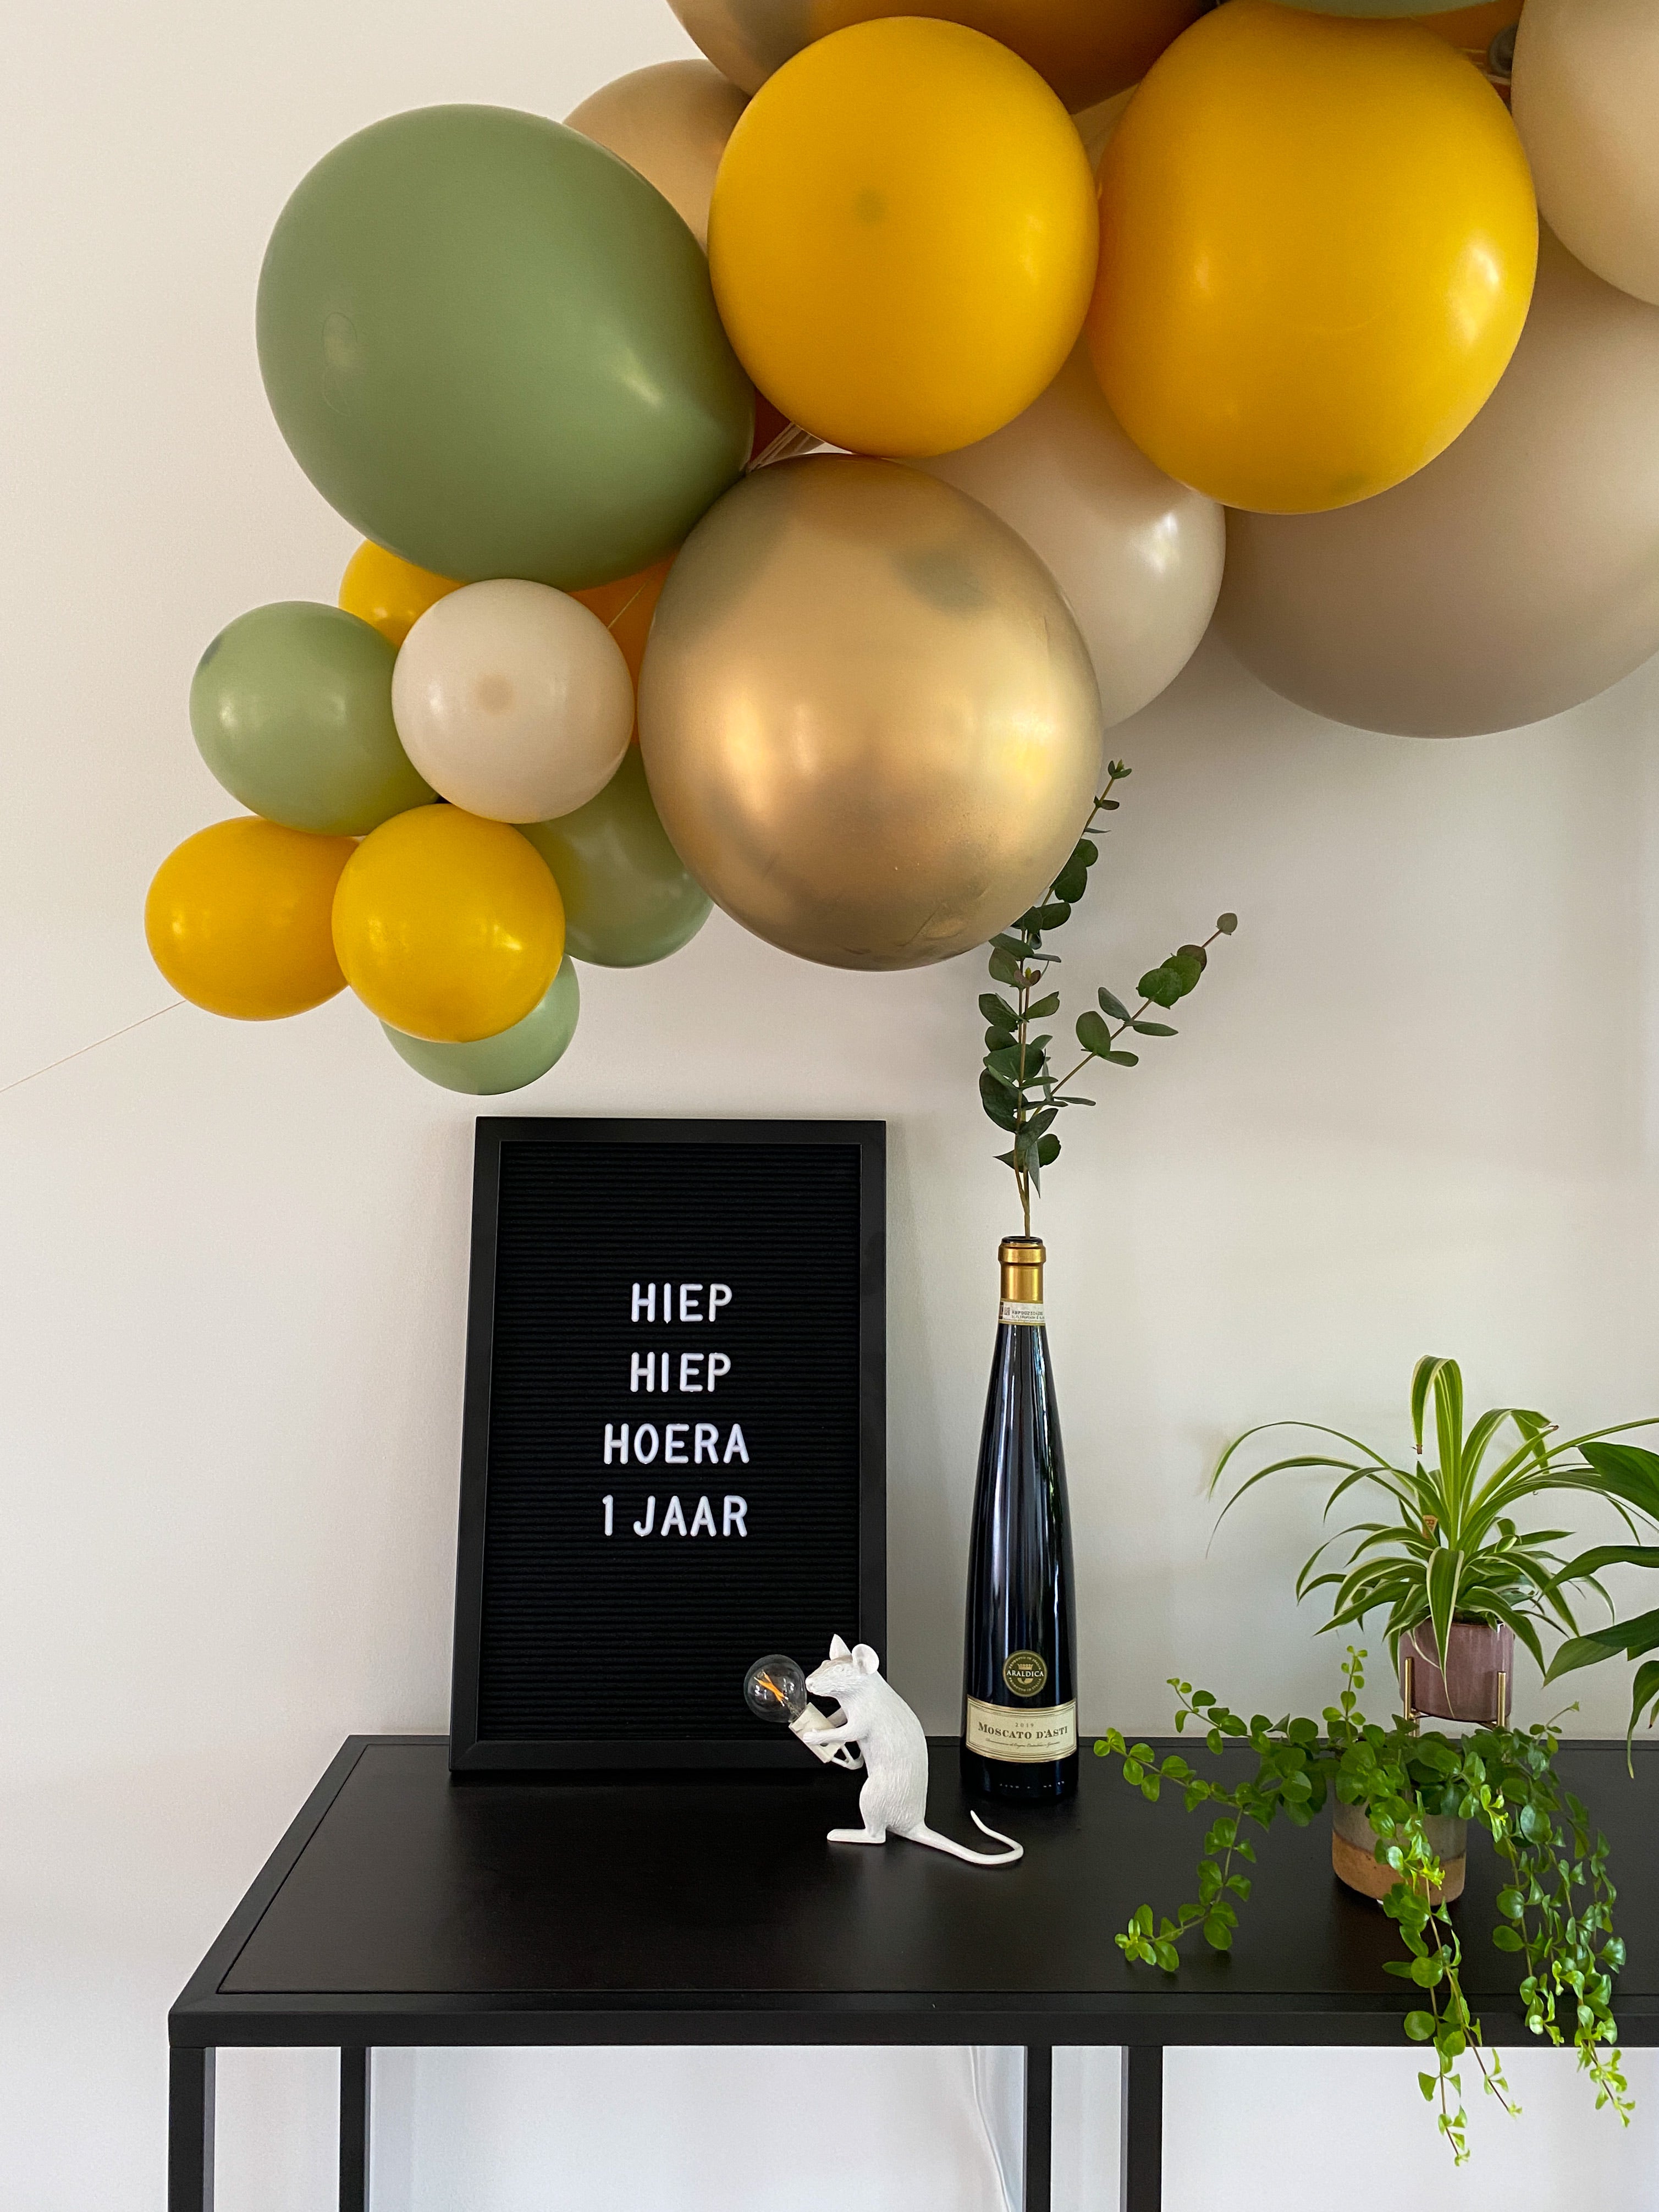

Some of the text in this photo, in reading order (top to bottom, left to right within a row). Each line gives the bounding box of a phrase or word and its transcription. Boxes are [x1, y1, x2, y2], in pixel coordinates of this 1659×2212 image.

[631, 1283, 732, 1323] HIEP
[630, 1352, 731, 1393] HIEP
[604, 1423, 749, 1464] HOERA
[602, 1494, 748, 1537] 1 JAAR
[978, 1721, 1068, 1740] MOSCATO D'ASTI
